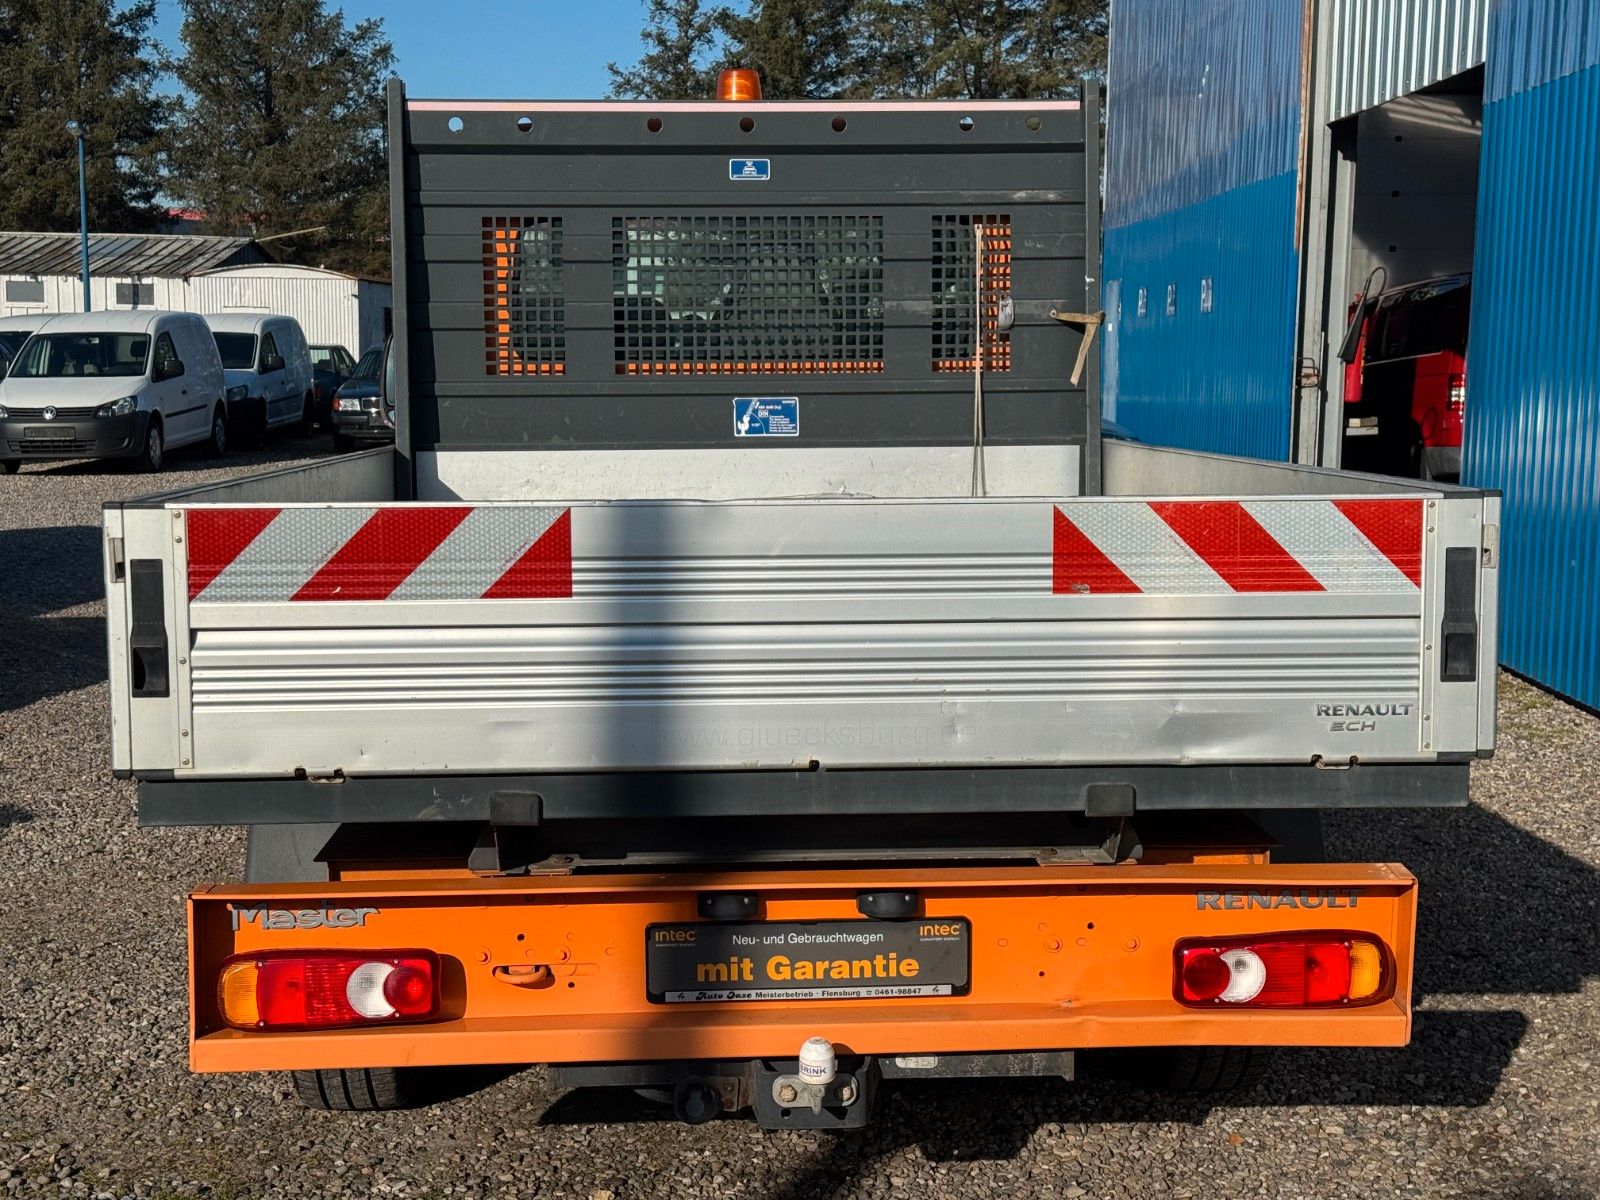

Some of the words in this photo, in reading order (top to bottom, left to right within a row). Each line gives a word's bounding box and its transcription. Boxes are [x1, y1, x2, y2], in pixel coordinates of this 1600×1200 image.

[1315, 703, 1414, 717] RENAULT
[1196, 888, 1365, 911] RENAULT
[227, 899, 380, 931] Master
[655, 930, 696, 942] intec
[920, 924, 960, 936] intec
[732, 934, 760, 945] Neu-
[763, 933, 784, 945] und
[786, 931, 884, 946] Gebrauchtwagen
[696, 956, 754, 982] mit
[766, 952, 920, 980] Garantie
[695, 991, 723, 1001] Auto
[755, 991, 814, 999] Meisterbetrieb
[821, 990, 861, 998] Flensburg
[874, 987, 922, 996] 0461-98847
